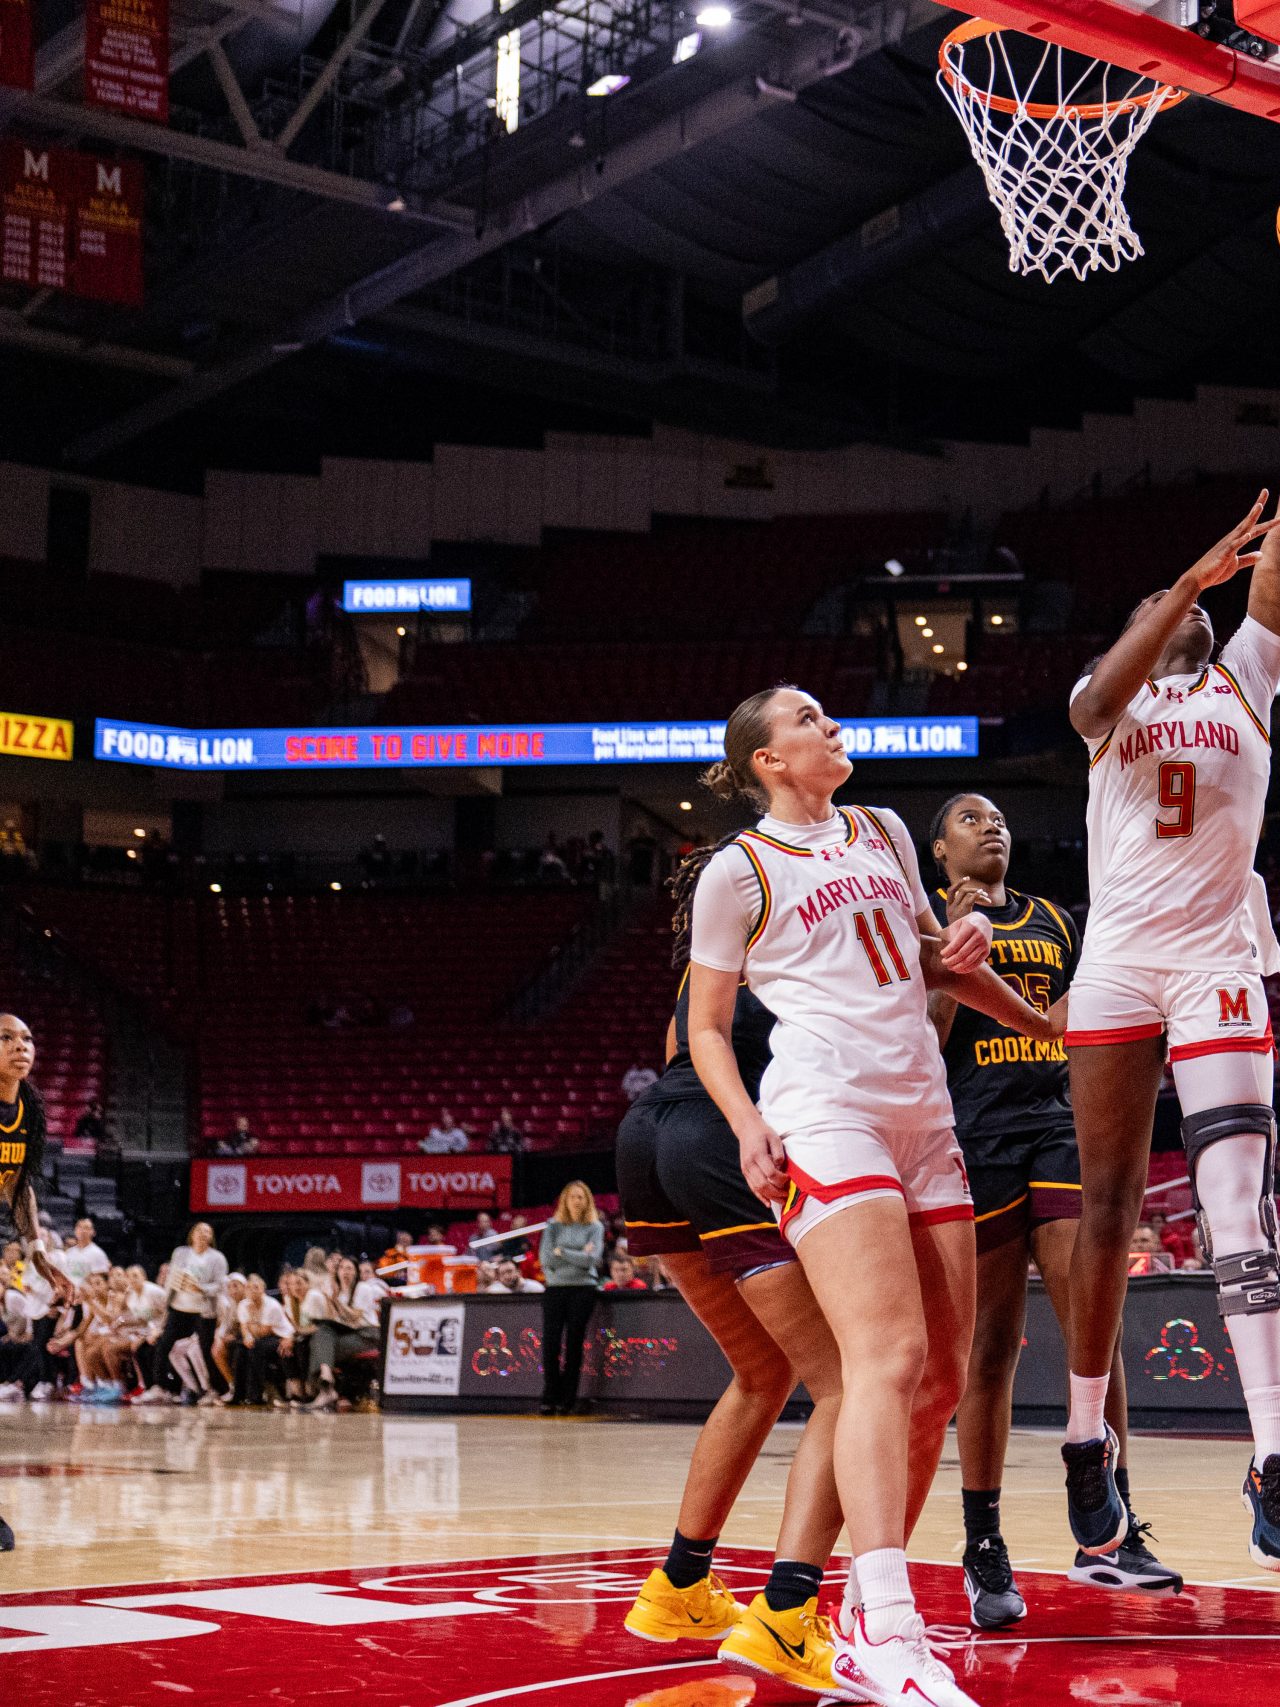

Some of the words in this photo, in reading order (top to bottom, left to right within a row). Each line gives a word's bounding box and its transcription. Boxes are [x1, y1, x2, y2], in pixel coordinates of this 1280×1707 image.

[24, 149, 49, 182] M
[96, 163, 122, 196] M
[353, 586, 396, 608] FOOD
[0, 720, 68, 753] IZZA
[103, 728, 165, 761] FOOD
[200, 738, 255, 765] LION
[285, 736, 358, 762] SCORE
[371, 735, 402, 759] TO
[412, 734, 467, 759] GIVE
[478, 732, 545, 758] MORE
[841, 728, 871, 753] OOD
[907, 727, 963, 753] LION
[1119, 720, 1239, 771] MARYLAND
[1156, 761, 1196, 839] 9
[797, 874, 911, 935] MARYLAND
[853, 908, 911, 988] 11
[984, 938, 1064, 970] THUNE
[1216, 988, 1252, 1022] M
[253, 1174, 342, 1194] TOYOTA
[406, 1172, 496, 1193] TOYOTA
